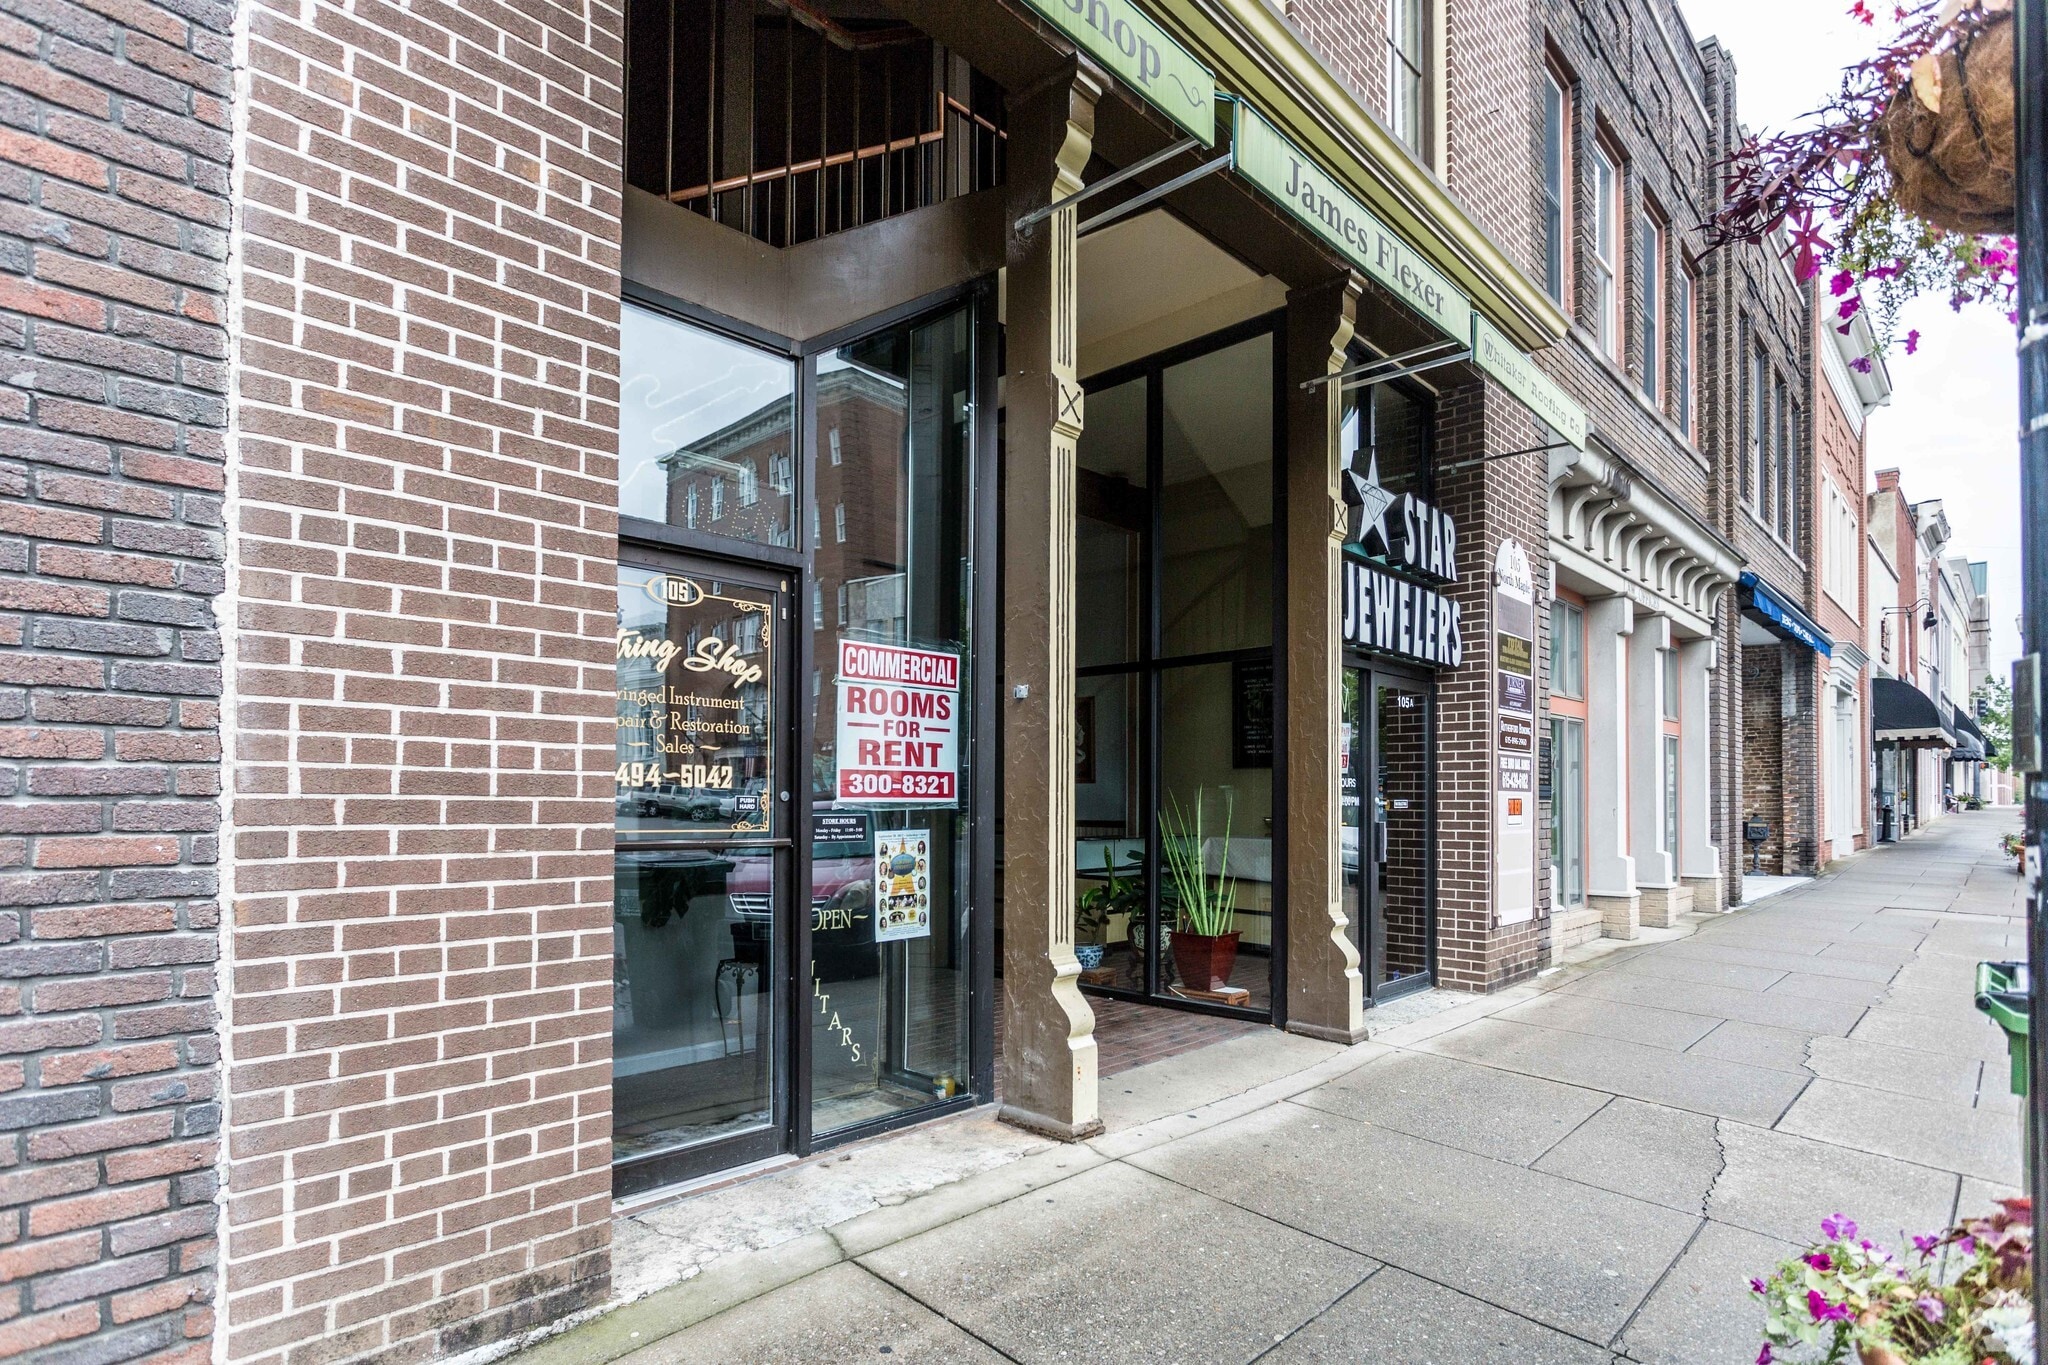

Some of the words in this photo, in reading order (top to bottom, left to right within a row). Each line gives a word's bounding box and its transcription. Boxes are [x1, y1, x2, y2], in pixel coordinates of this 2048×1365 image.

[1062, 0, 1161, 88] hop
[1285, 156, 1368, 255] James
[1375, 231, 1444, 316] Flexer
[1483, 333, 1527, 387] Whitaker
[1531, 381, 1567, 426] Roofing
[1571, 416, 1583, 438] Co.
[1404, 492, 1458, 582] STAR
[1510, 554, 1521, 573] 105
[661, 580, 689, 602] 105
[1497, 567, 1514, 587] North
[1514, 575, 1531, 595] Maple
[1344, 561, 1463, 668] JEWELERS
[683, 637, 762, 689] Shop
[845, 647, 955, 685] COMMERCIAL
[669, 686, 745, 710] Instrument
[847, 686, 951, 720] ROOMS
[1397, 695, 1414, 708] 105A
[650, 710, 668, 729] &
[670, 711, 750, 734] Restoration
[883, 720, 920, 738] FOR
[656, 734, 695, 754] Sales
[858, 739, 943, 768] RENT
[849, 773, 949, 794] 300-8321
